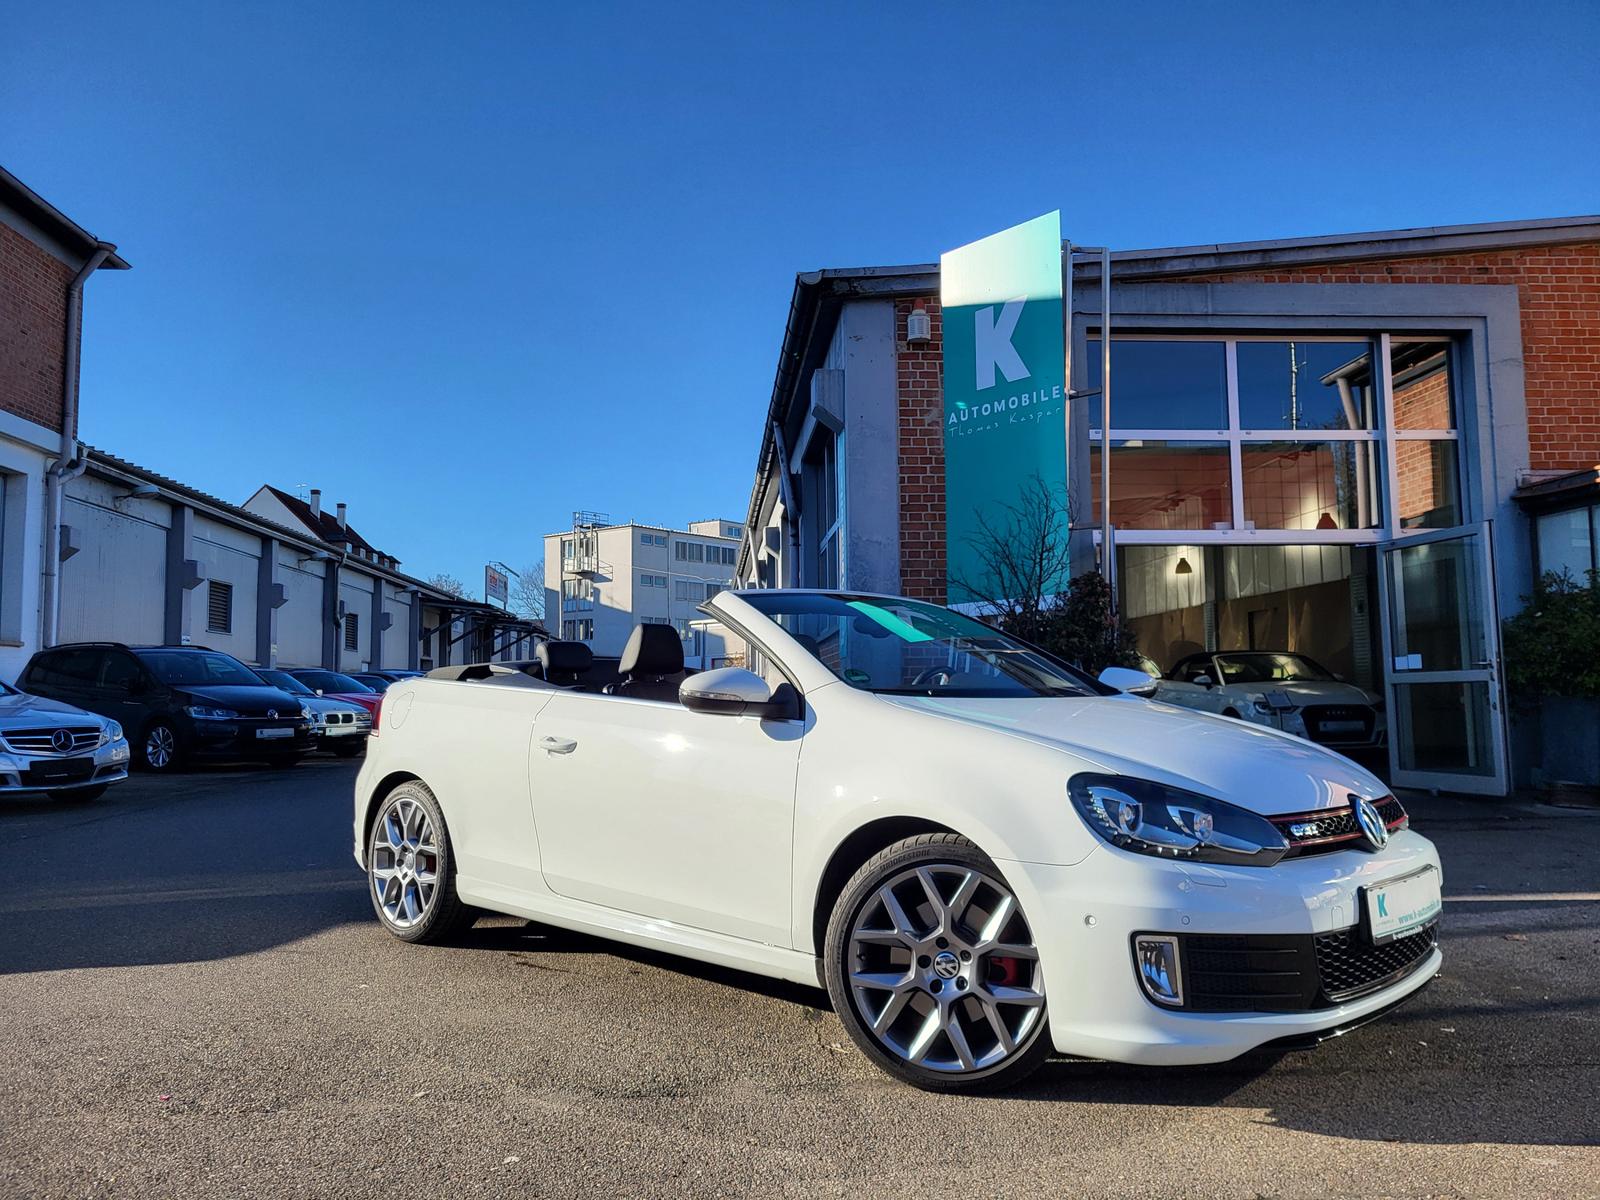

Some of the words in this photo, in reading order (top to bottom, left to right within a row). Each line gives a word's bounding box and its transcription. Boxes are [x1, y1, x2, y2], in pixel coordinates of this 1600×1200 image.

[975, 294, 1031, 390] K
[949, 385, 1061, 425] AUTOMOBILE
[949, 422, 1000, 438] Thomas
[1377, 892, 1388, 917] K
